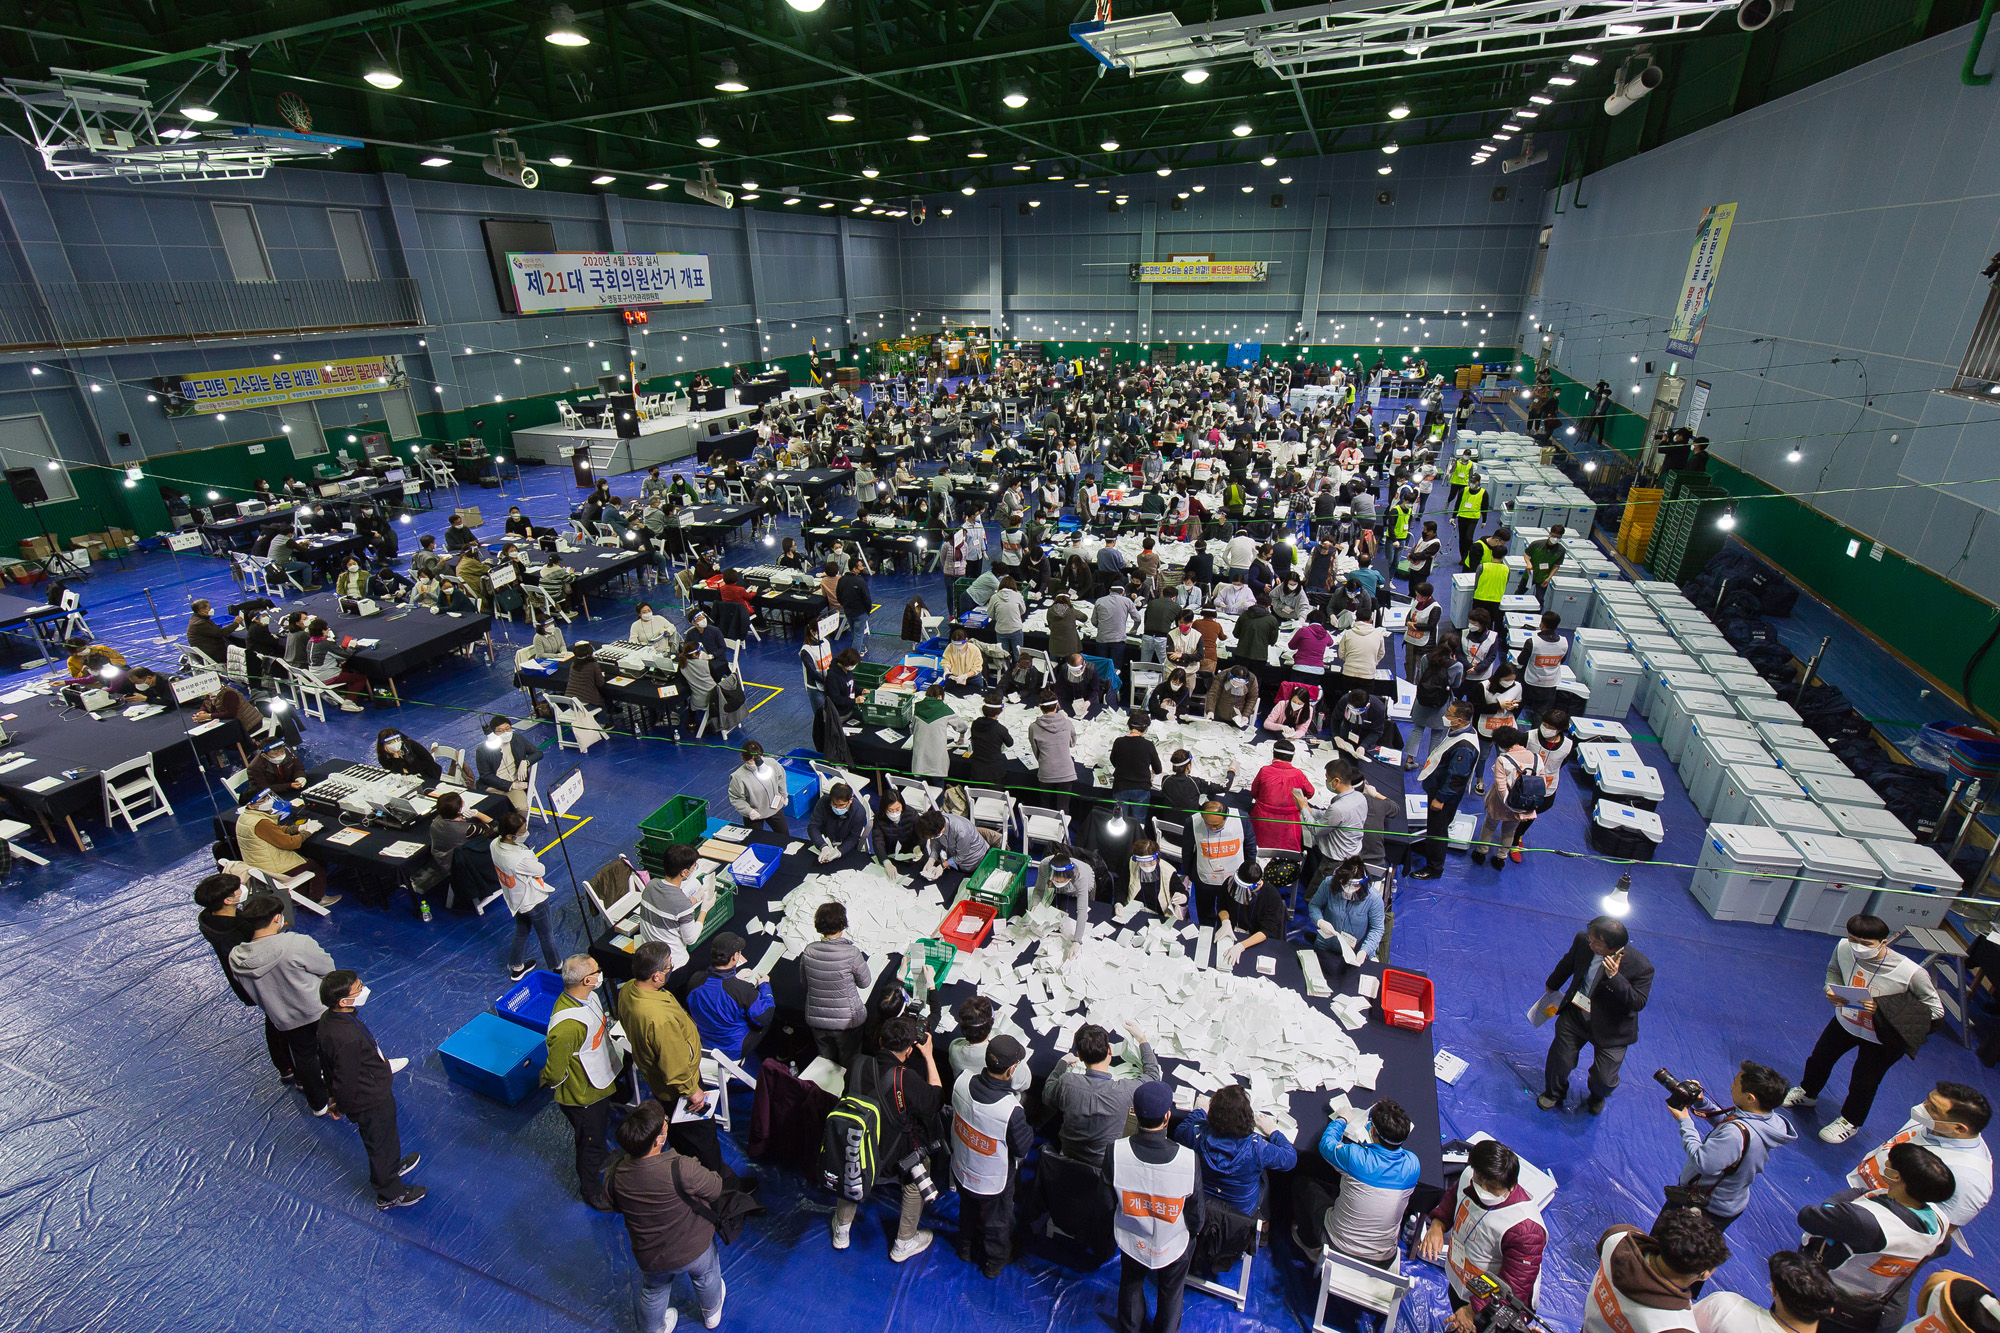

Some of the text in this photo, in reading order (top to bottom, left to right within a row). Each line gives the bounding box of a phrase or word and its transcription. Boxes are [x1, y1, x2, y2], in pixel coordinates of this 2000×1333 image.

[582, 255, 660, 267] 2020년 4월 15일 실시
[1140, 265, 1160, 275] 배드민턴
[1211, 265, 1233, 275] 배드민턴
[524, 268, 706, 296] 제21대 국회의원선거 개표
[607, 292, 660, 304] 영등포구선거관리위원회
[180, 362, 391, 401] 배드민턴 고수되는 숨은 비결!! 배드민턴 필라테스
[1205, 843, 1237, 855] 개표참관
[955, 1120, 990, 1151] 개표참관
[843, 1127, 864, 1201] arena
[1129, 1197, 1180, 1217] 개표참관
